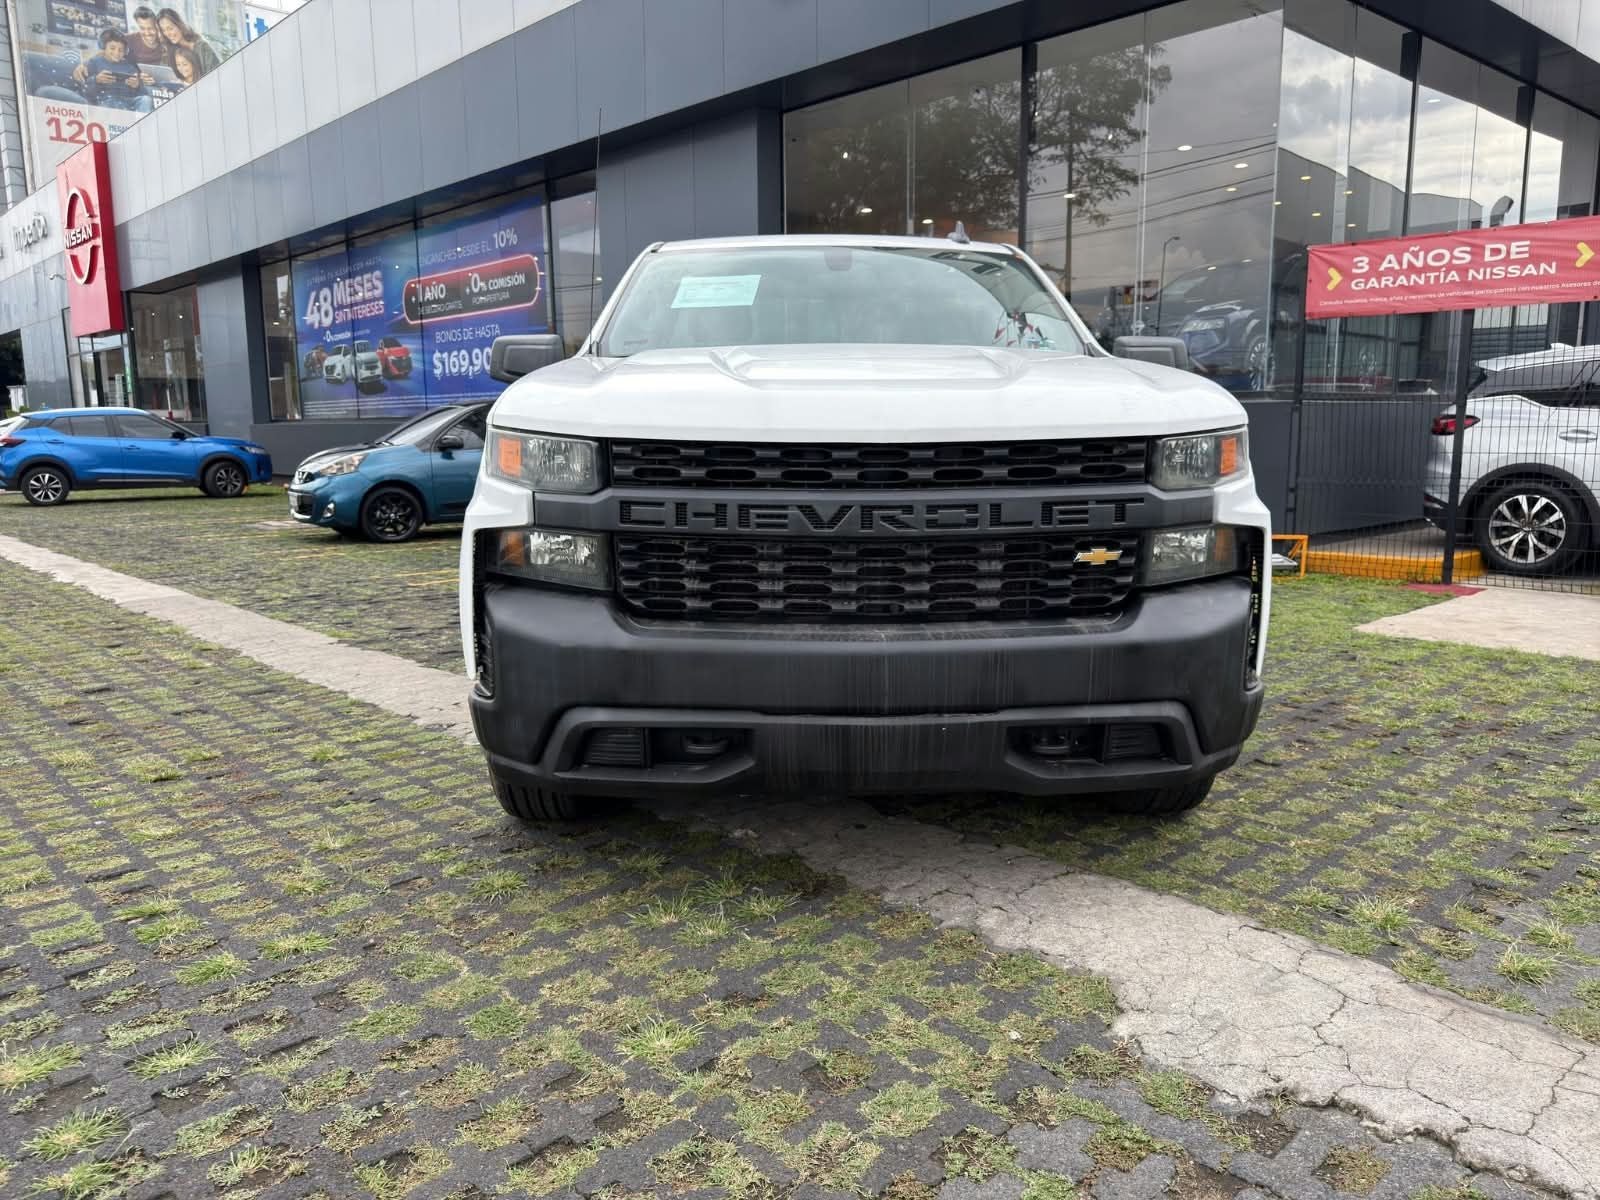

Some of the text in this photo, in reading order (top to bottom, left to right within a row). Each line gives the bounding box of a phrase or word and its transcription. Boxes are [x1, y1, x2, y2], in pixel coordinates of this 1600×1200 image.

[45, 105, 84, 119] AHORA
[46, 117, 107, 144] 120
[65, 224, 92, 250] NISSAN
[458, 242, 480, 258] DESDE
[481, 240, 492, 254] EL
[493, 227, 518, 249] 10%
[1351, 240, 1531, 274] 3 AÑOS DE
[333, 270, 384, 308] MESES
[488, 272, 525, 290] COMISIÓN
[1351, 262, 1557, 291] GARANTÍA NISSAN
[1561, 281, 1591, 289] Asesores
[424, 281, 446, 302] AÑO
[306, 287, 333, 329] 48
[335, 301, 385, 324] SIN INTERESES
[435, 323, 500, 343] BONOS DE HASTA
[619, 500, 1145, 531] CHEVROLET
